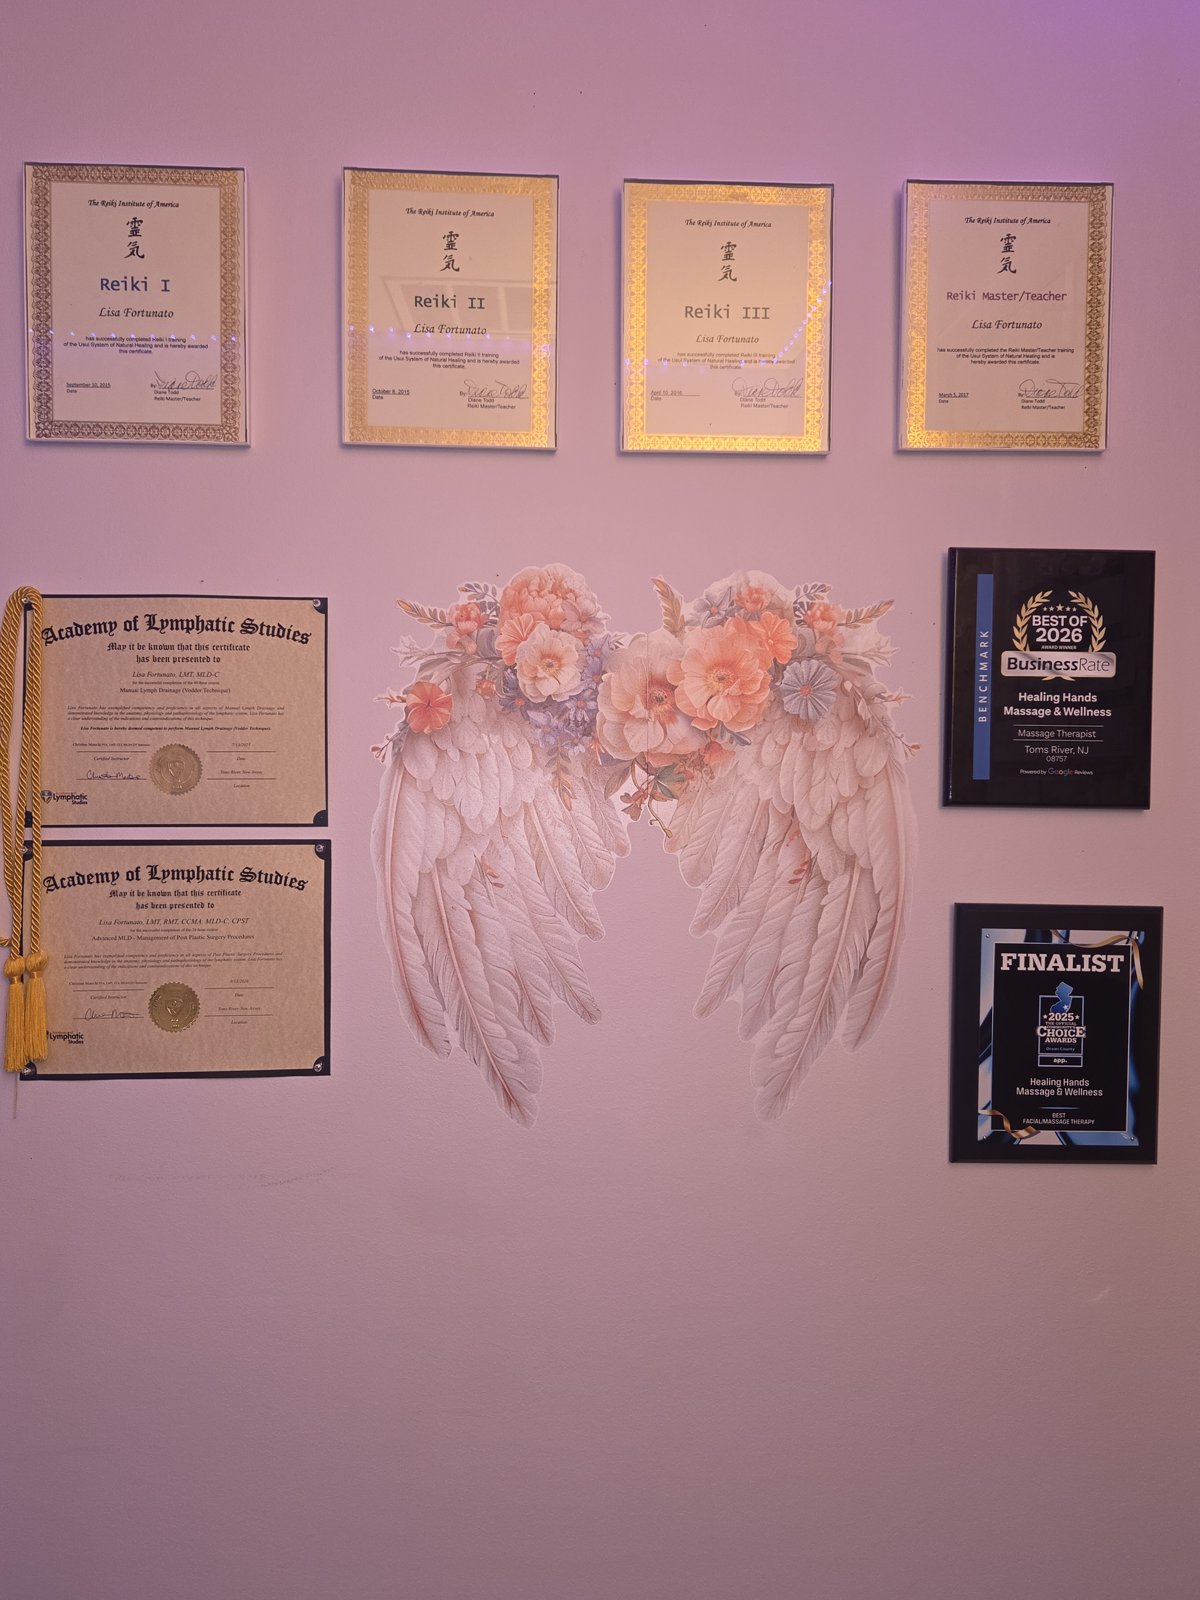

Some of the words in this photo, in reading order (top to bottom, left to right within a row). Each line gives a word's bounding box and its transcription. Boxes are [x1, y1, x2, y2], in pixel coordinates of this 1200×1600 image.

[146, 200, 153, 209] of
[418, 208, 434, 216] Reiki
[462, 210, 469, 218] of
[740, 220, 747, 228] of
[100, 276, 148, 291] Reiki
[161, 280, 170, 292] I
[946, 290, 976, 300] Reiki
[982, 291, 1067, 302] Master/Teacher
[415, 294, 456, 308] Reiki
[468, 297, 485, 309] II
[99, 307, 120, 317] Lisa
[124, 308, 174, 318] Fortunato
[684, 304, 730, 319] Reiki
[742, 307, 770, 319] III
[413, 324, 434, 333] Lisa
[438, 324, 486, 335] Fortunato
[972, 320, 992, 329] Lisa
[994, 320, 1042, 330] Fortunato
[696, 334, 714, 343] Lisa
[716, 335, 760, 344] Fortunato
[1032, 615, 1067, 626] BEST
[1068, 615, 1088, 627] OF
[42, 620, 117, 646] Academy
[123, 615, 139, 632] of
[144, 614, 235, 634] Lymphatic
[240, 618, 312, 645] Studies
[1036, 628, 1083, 643] 2026
[107, 642, 127, 652] May
[129, 642, 135, 651] it
[137, 643, 145, 651] be
[148, 643, 176, 651] known
[178, 643, 192, 652] that
[195, 643, 209, 652] this
[212, 643, 250, 652] certificate
[136, 655, 149, 663] has
[172, 655, 210, 663] presented
[1007, 657, 1110, 672] BusinessRate
[978, 631, 989, 722] BENCHMARK
[1018, 692, 1059, 703] Healing
[1062, 693, 1097, 702] Hands
[1003, 706, 1051, 718] Massage
[1053, 707, 1061, 716] &
[1063, 707, 1112, 717] Wellness
[1018, 729, 1055, 739] Massage
[1057, 730, 1096, 738] Therapist
[1051, 746, 1076, 754] River,
[1048, 768, 1073, 776] Google
[53, 792, 88, 802] Lymphatic
[43, 870, 120, 894] Academy
[126, 866, 141, 881] of
[146, 864, 235, 883] Lymphatic
[240, 867, 309, 891] Studies
[109, 890, 128, 898] May
[207, 889, 241, 897] certificate
[169, 902, 204, 910] presented
[1001, 953, 1124, 972] FINALIST
[1048, 1013, 1074, 1021] 2025
[50, 1032, 84, 1041] Lymphatic
[1037, 1026, 1086, 1038] CHOICE
[1030, 1078, 1061, 1087] Healing
[1063, 1078, 1090, 1086] Hands
[1016, 1088, 1055, 1097] Massage
[1064, 1088, 1103, 1096] Wellness
